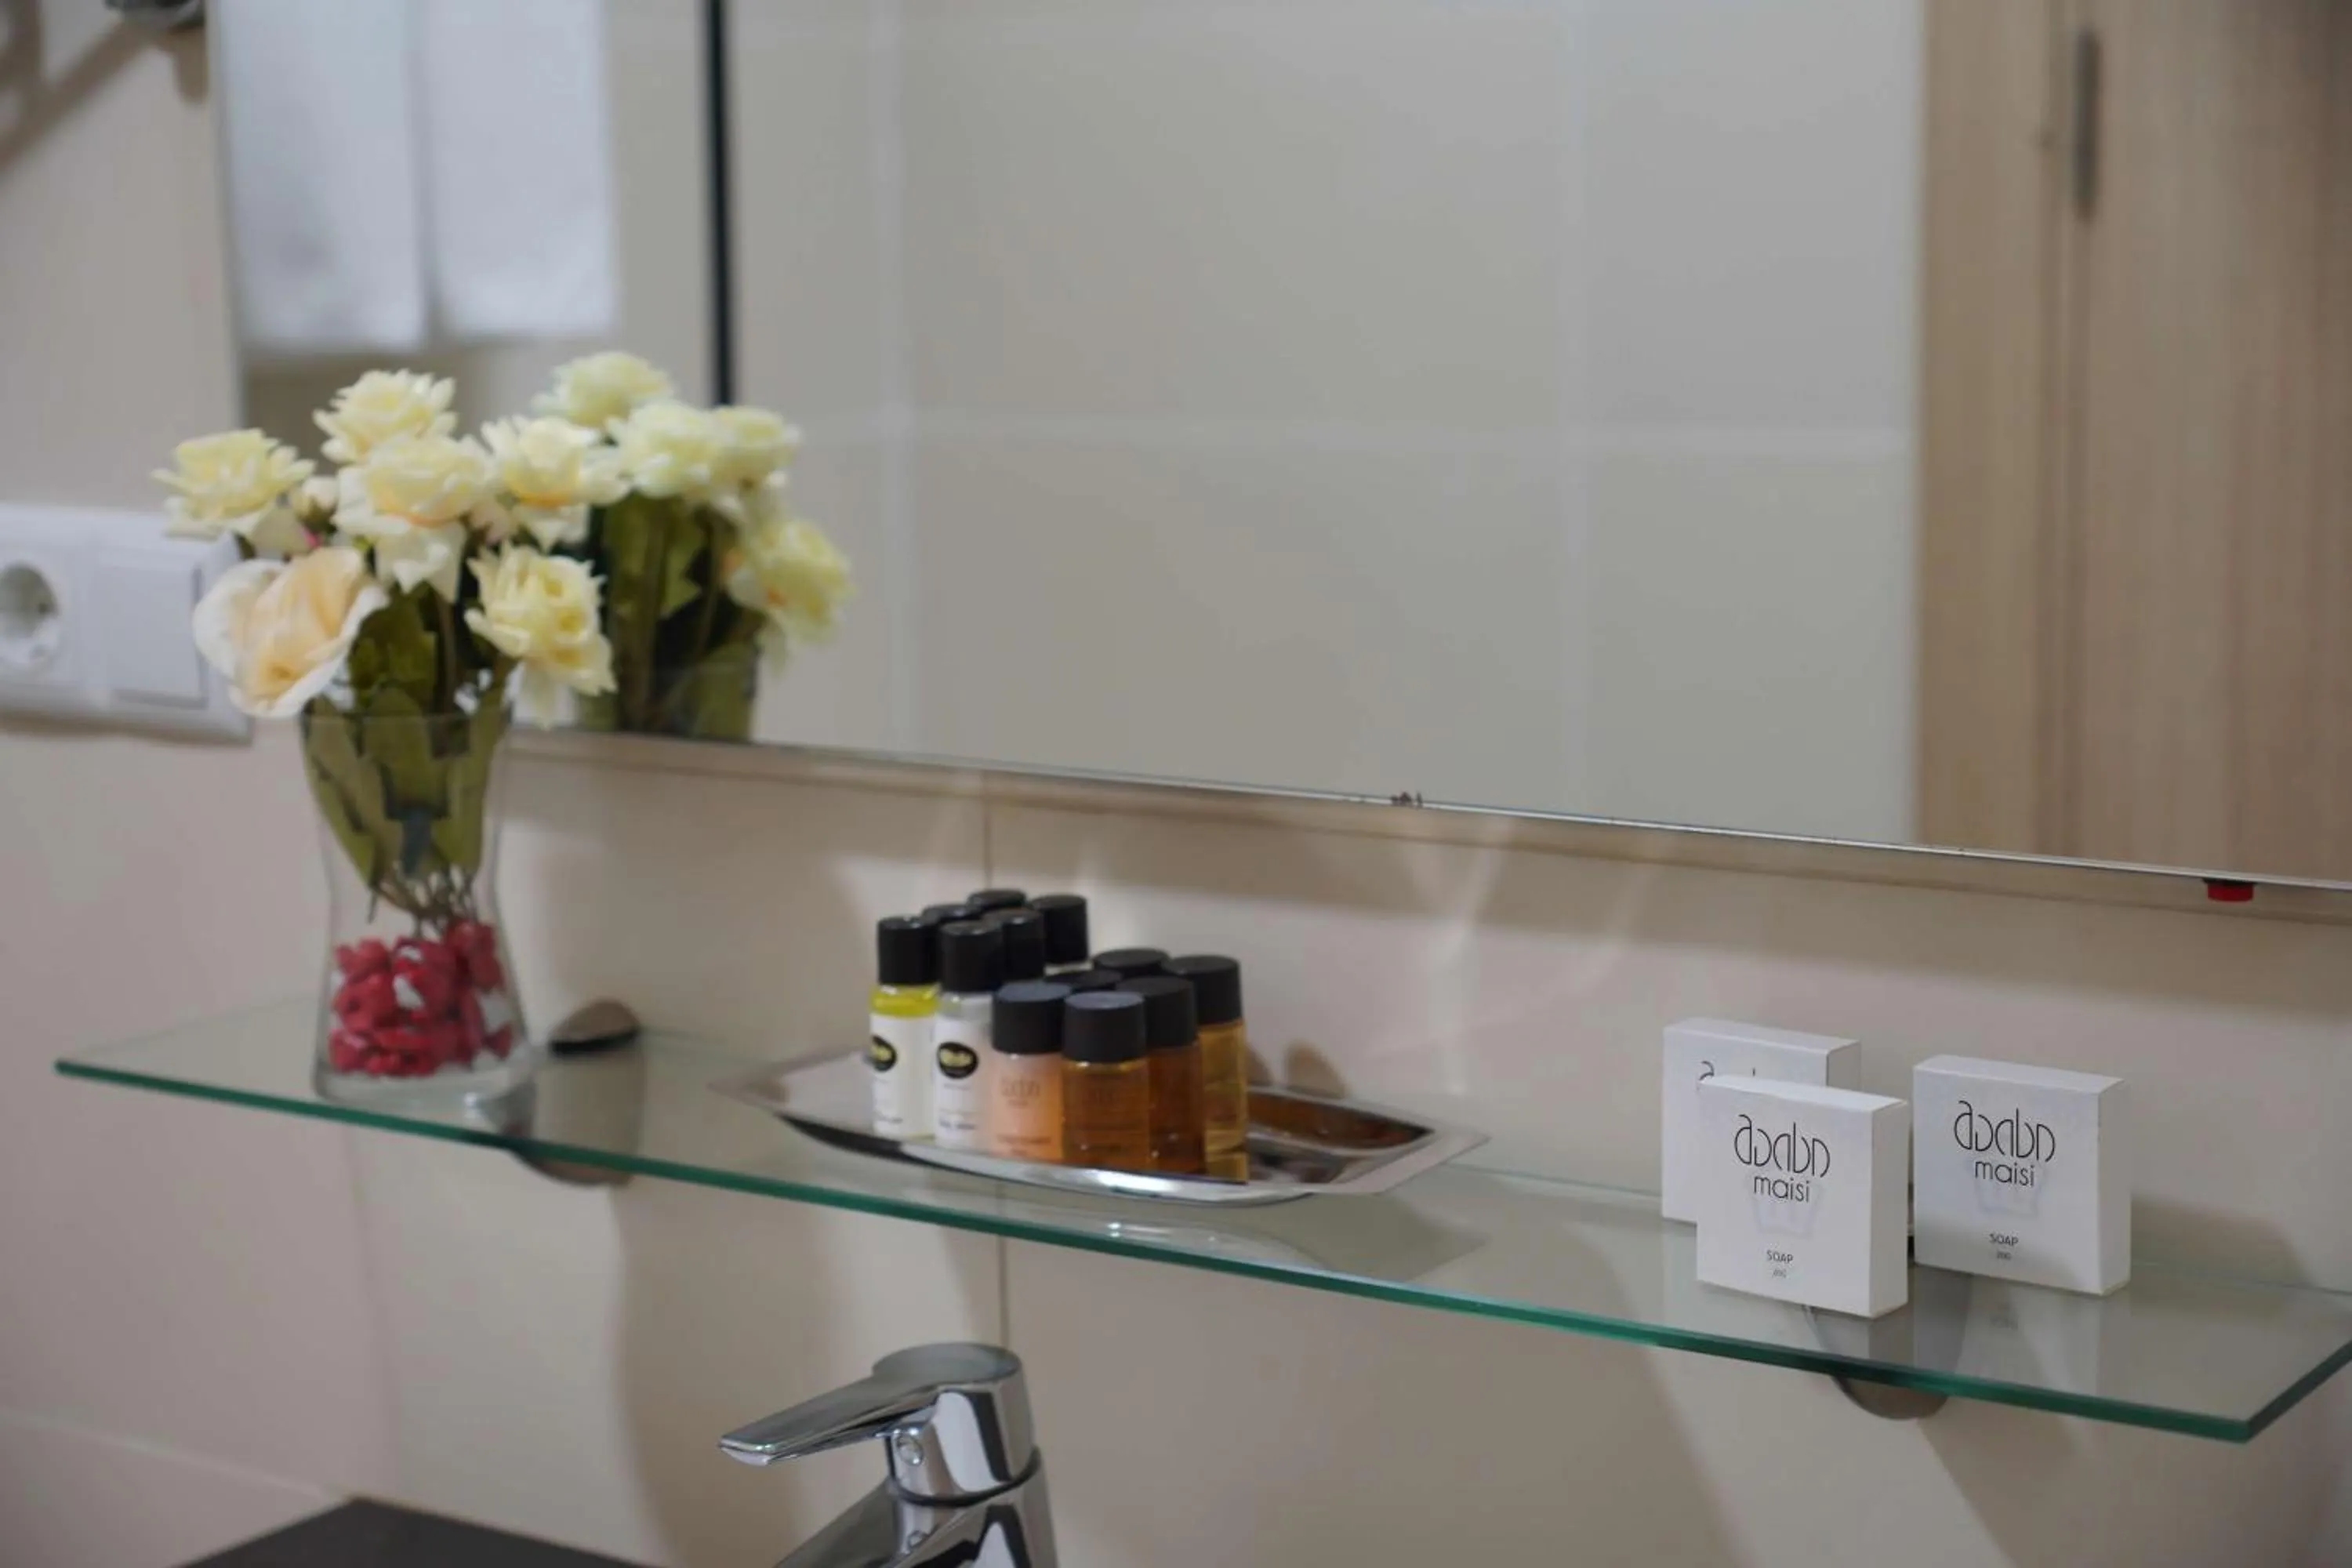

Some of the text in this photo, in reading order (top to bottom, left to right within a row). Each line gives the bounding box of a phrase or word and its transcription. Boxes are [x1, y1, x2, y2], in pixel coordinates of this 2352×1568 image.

[1975, 1161, 2034, 1186] maisi
[1754, 1176, 1809, 1203] maisi
[1989, 1233, 2019, 1246] SOAP
[1766, 1250, 1794, 1263] SOAP
